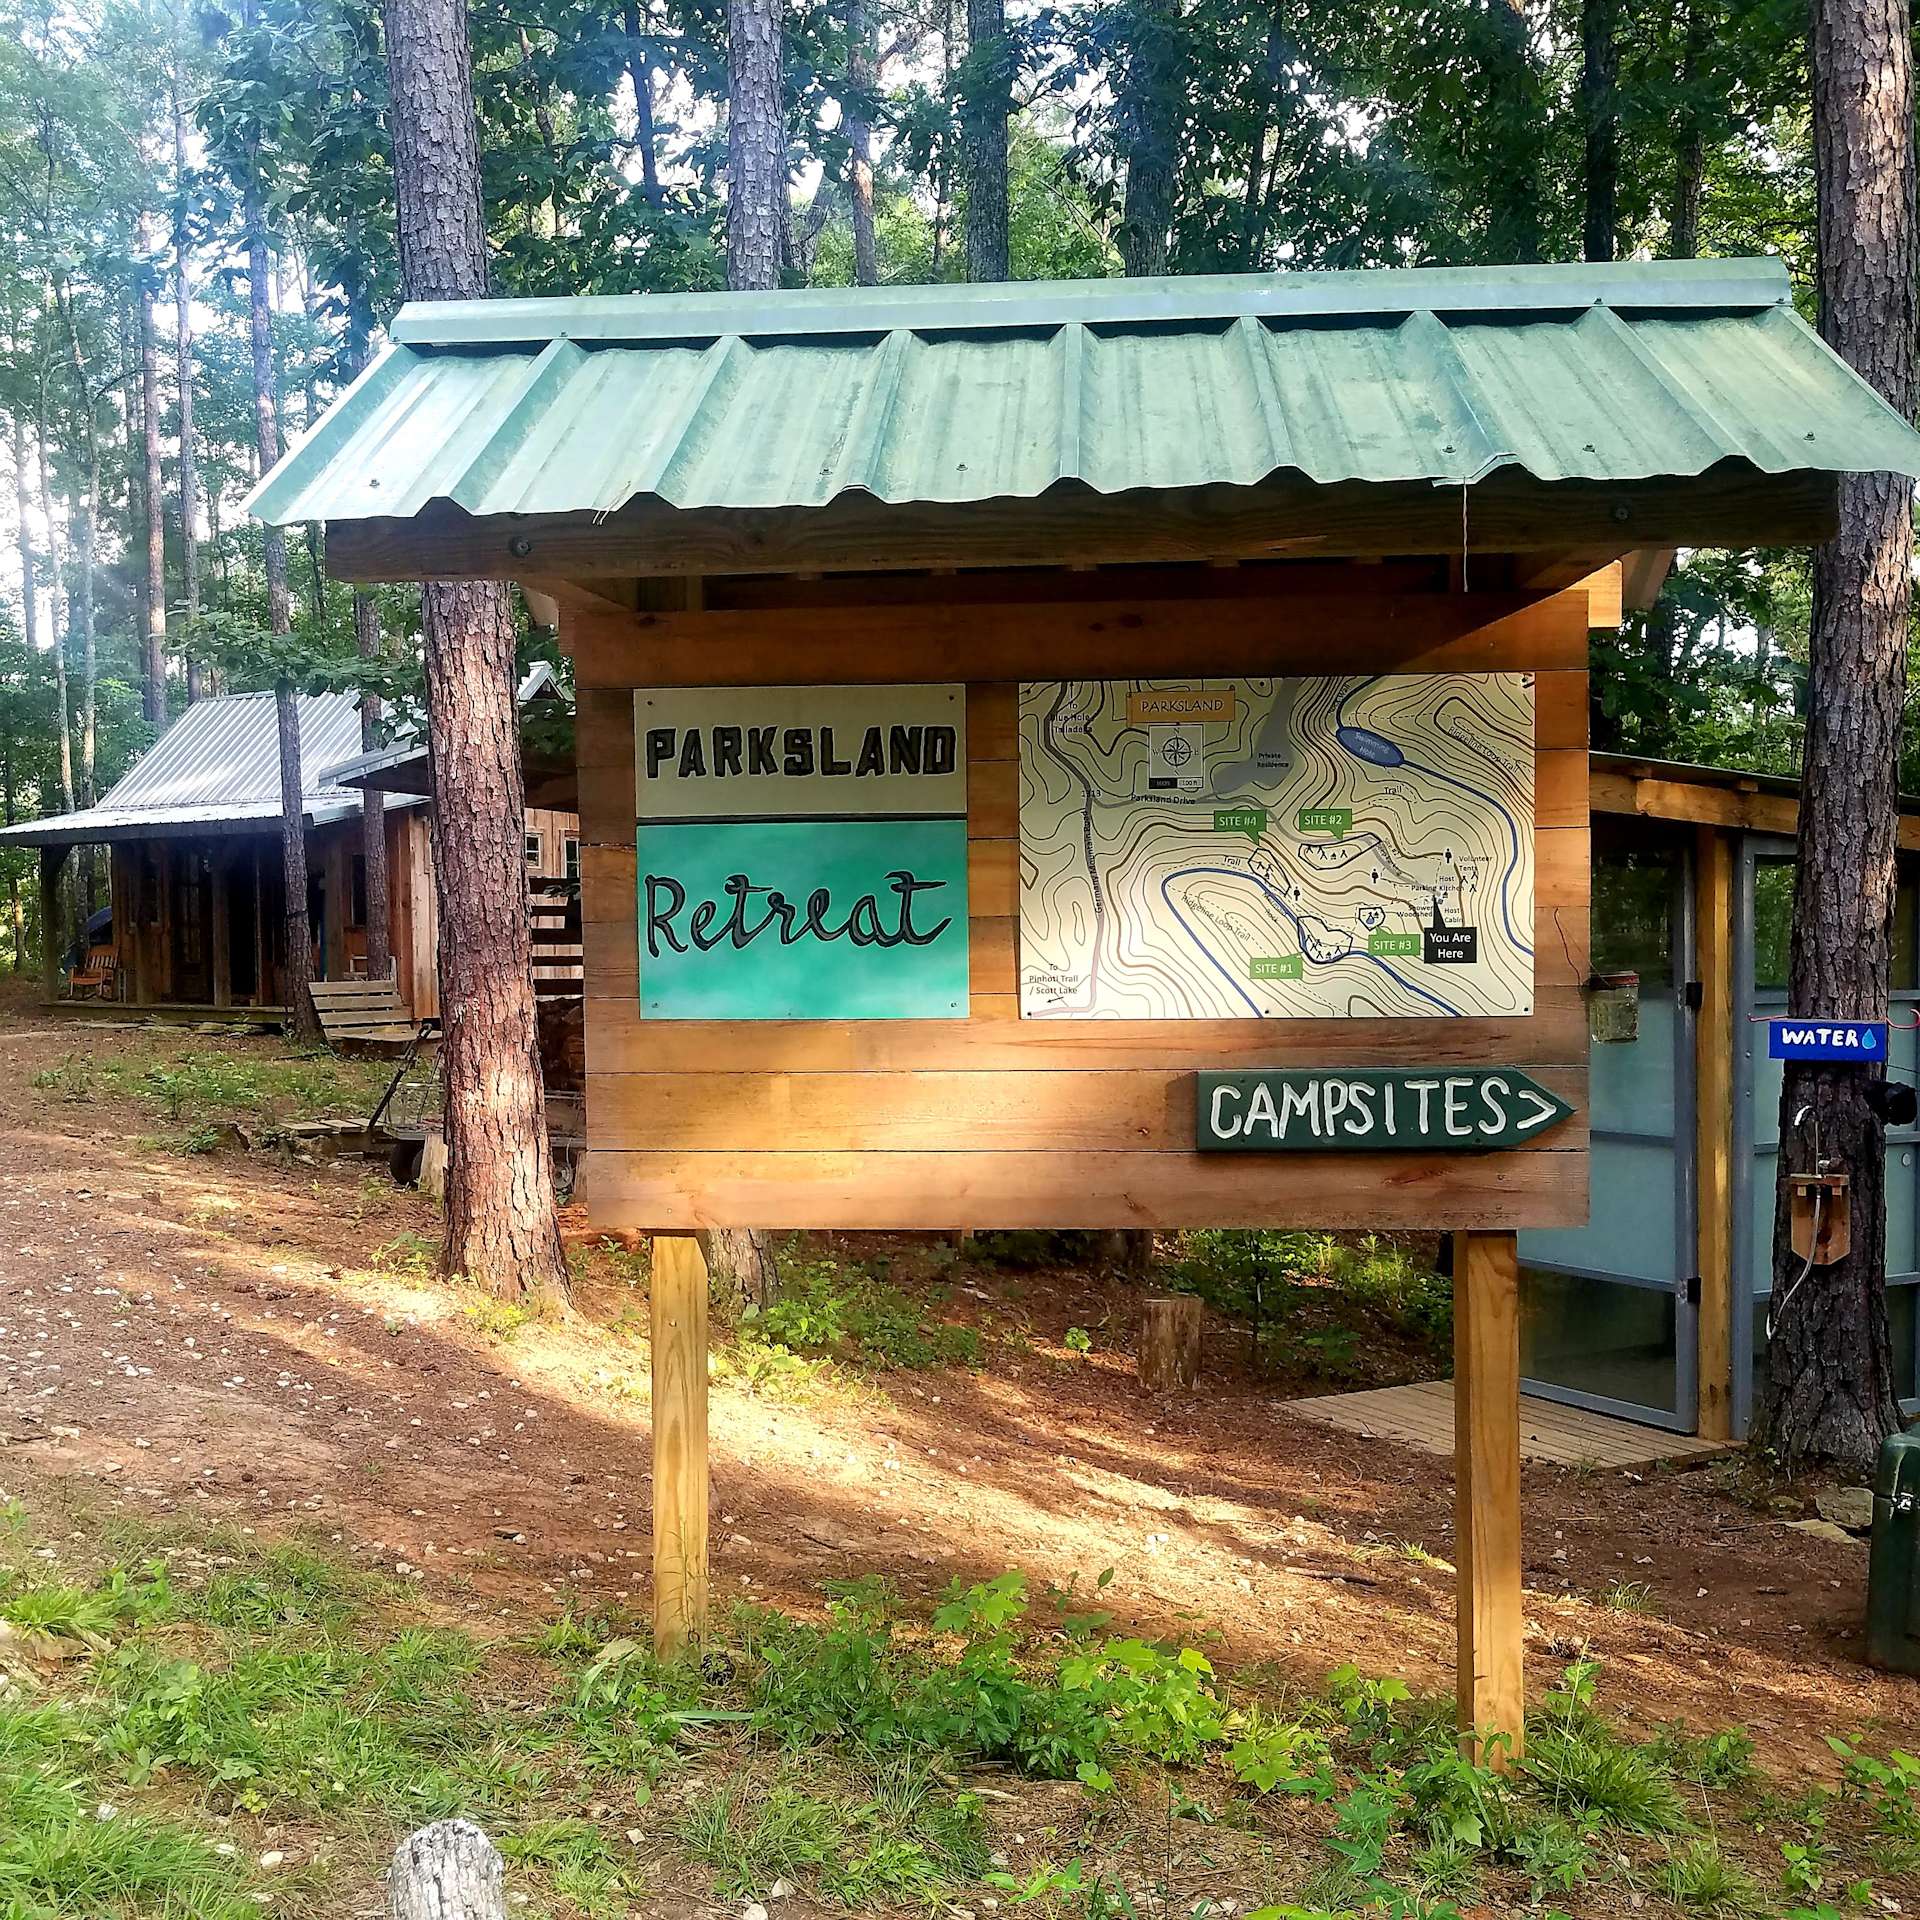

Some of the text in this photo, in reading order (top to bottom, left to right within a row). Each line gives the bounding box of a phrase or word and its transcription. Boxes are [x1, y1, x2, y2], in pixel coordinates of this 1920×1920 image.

[1142, 700, 1224, 712] PARKSLAND
[645, 725, 957, 778] PARKSLAND
[1384, 785, 1402, 794] Trail
[1173, 796, 1196, 805] Drive
[1220, 815, 1241, 826] SITE
[1304, 814, 1342, 825] SITE #2
[1223, 856, 1241, 866] Trail
[645, 870, 953, 959] Retreat
[1430, 932, 1472, 943] You Are
[1374, 939, 1412, 950] SITE #3
[1437, 948, 1464, 959] Here
[1049, 963, 1058, 971] To
[1255, 963, 1293, 974] SITE #1
[1061, 975, 1079, 983] Trail
[1036, 986, 1058, 994] Scott
[1781, 1027, 1859, 1048] WATER
[1210, 1077, 1511, 1139] CAMPSITES
